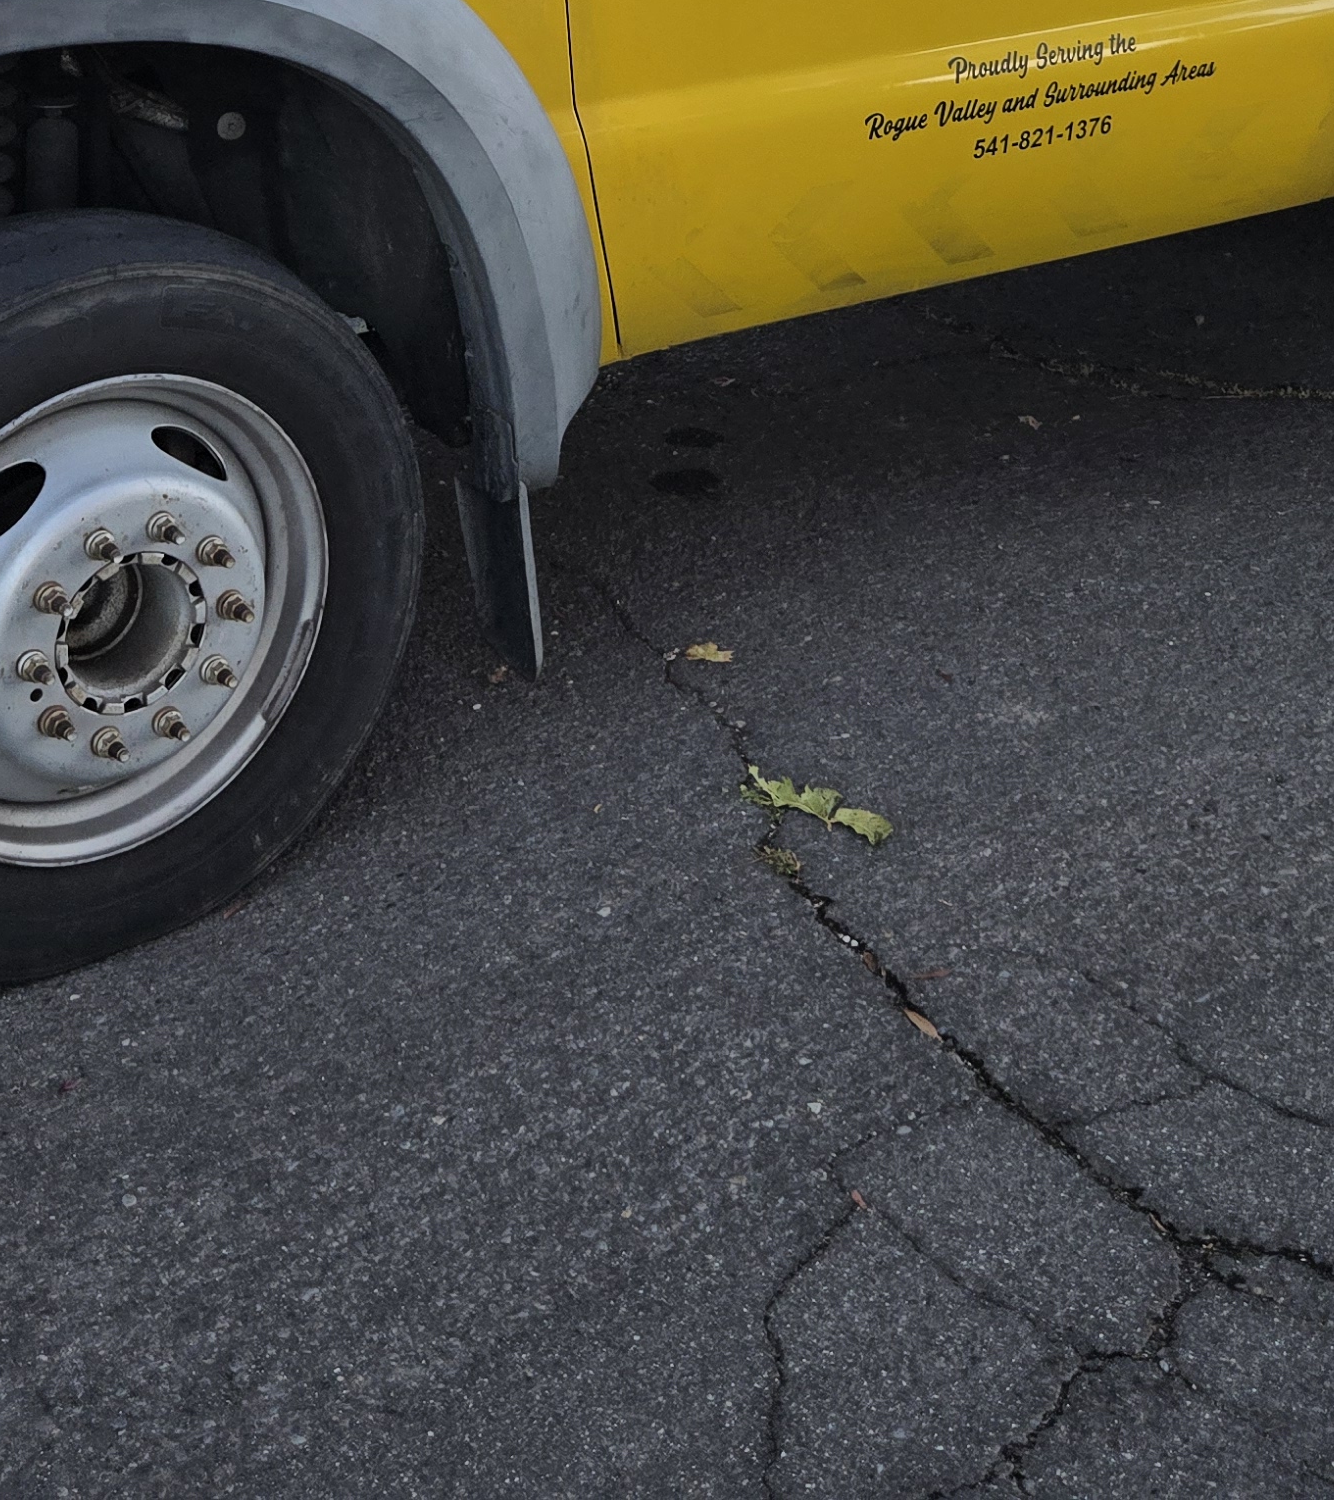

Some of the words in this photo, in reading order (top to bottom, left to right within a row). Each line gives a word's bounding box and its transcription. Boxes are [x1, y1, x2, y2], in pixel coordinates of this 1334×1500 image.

[948, 51, 1029, 84] Proudly
[1036, 41, 1105, 70] Serving
[1109, 33, 1137, 54] the
[865, 112, 928, 141] Rogue
[934, 99, 997, 127] Valley
[1002, 88, 1037, 113] and
[1044, 71, 1158, 108] Surrounding
[1160, 59, 1216, 86] Areas
[973, 114, 1112, 159] 541-821-1376
